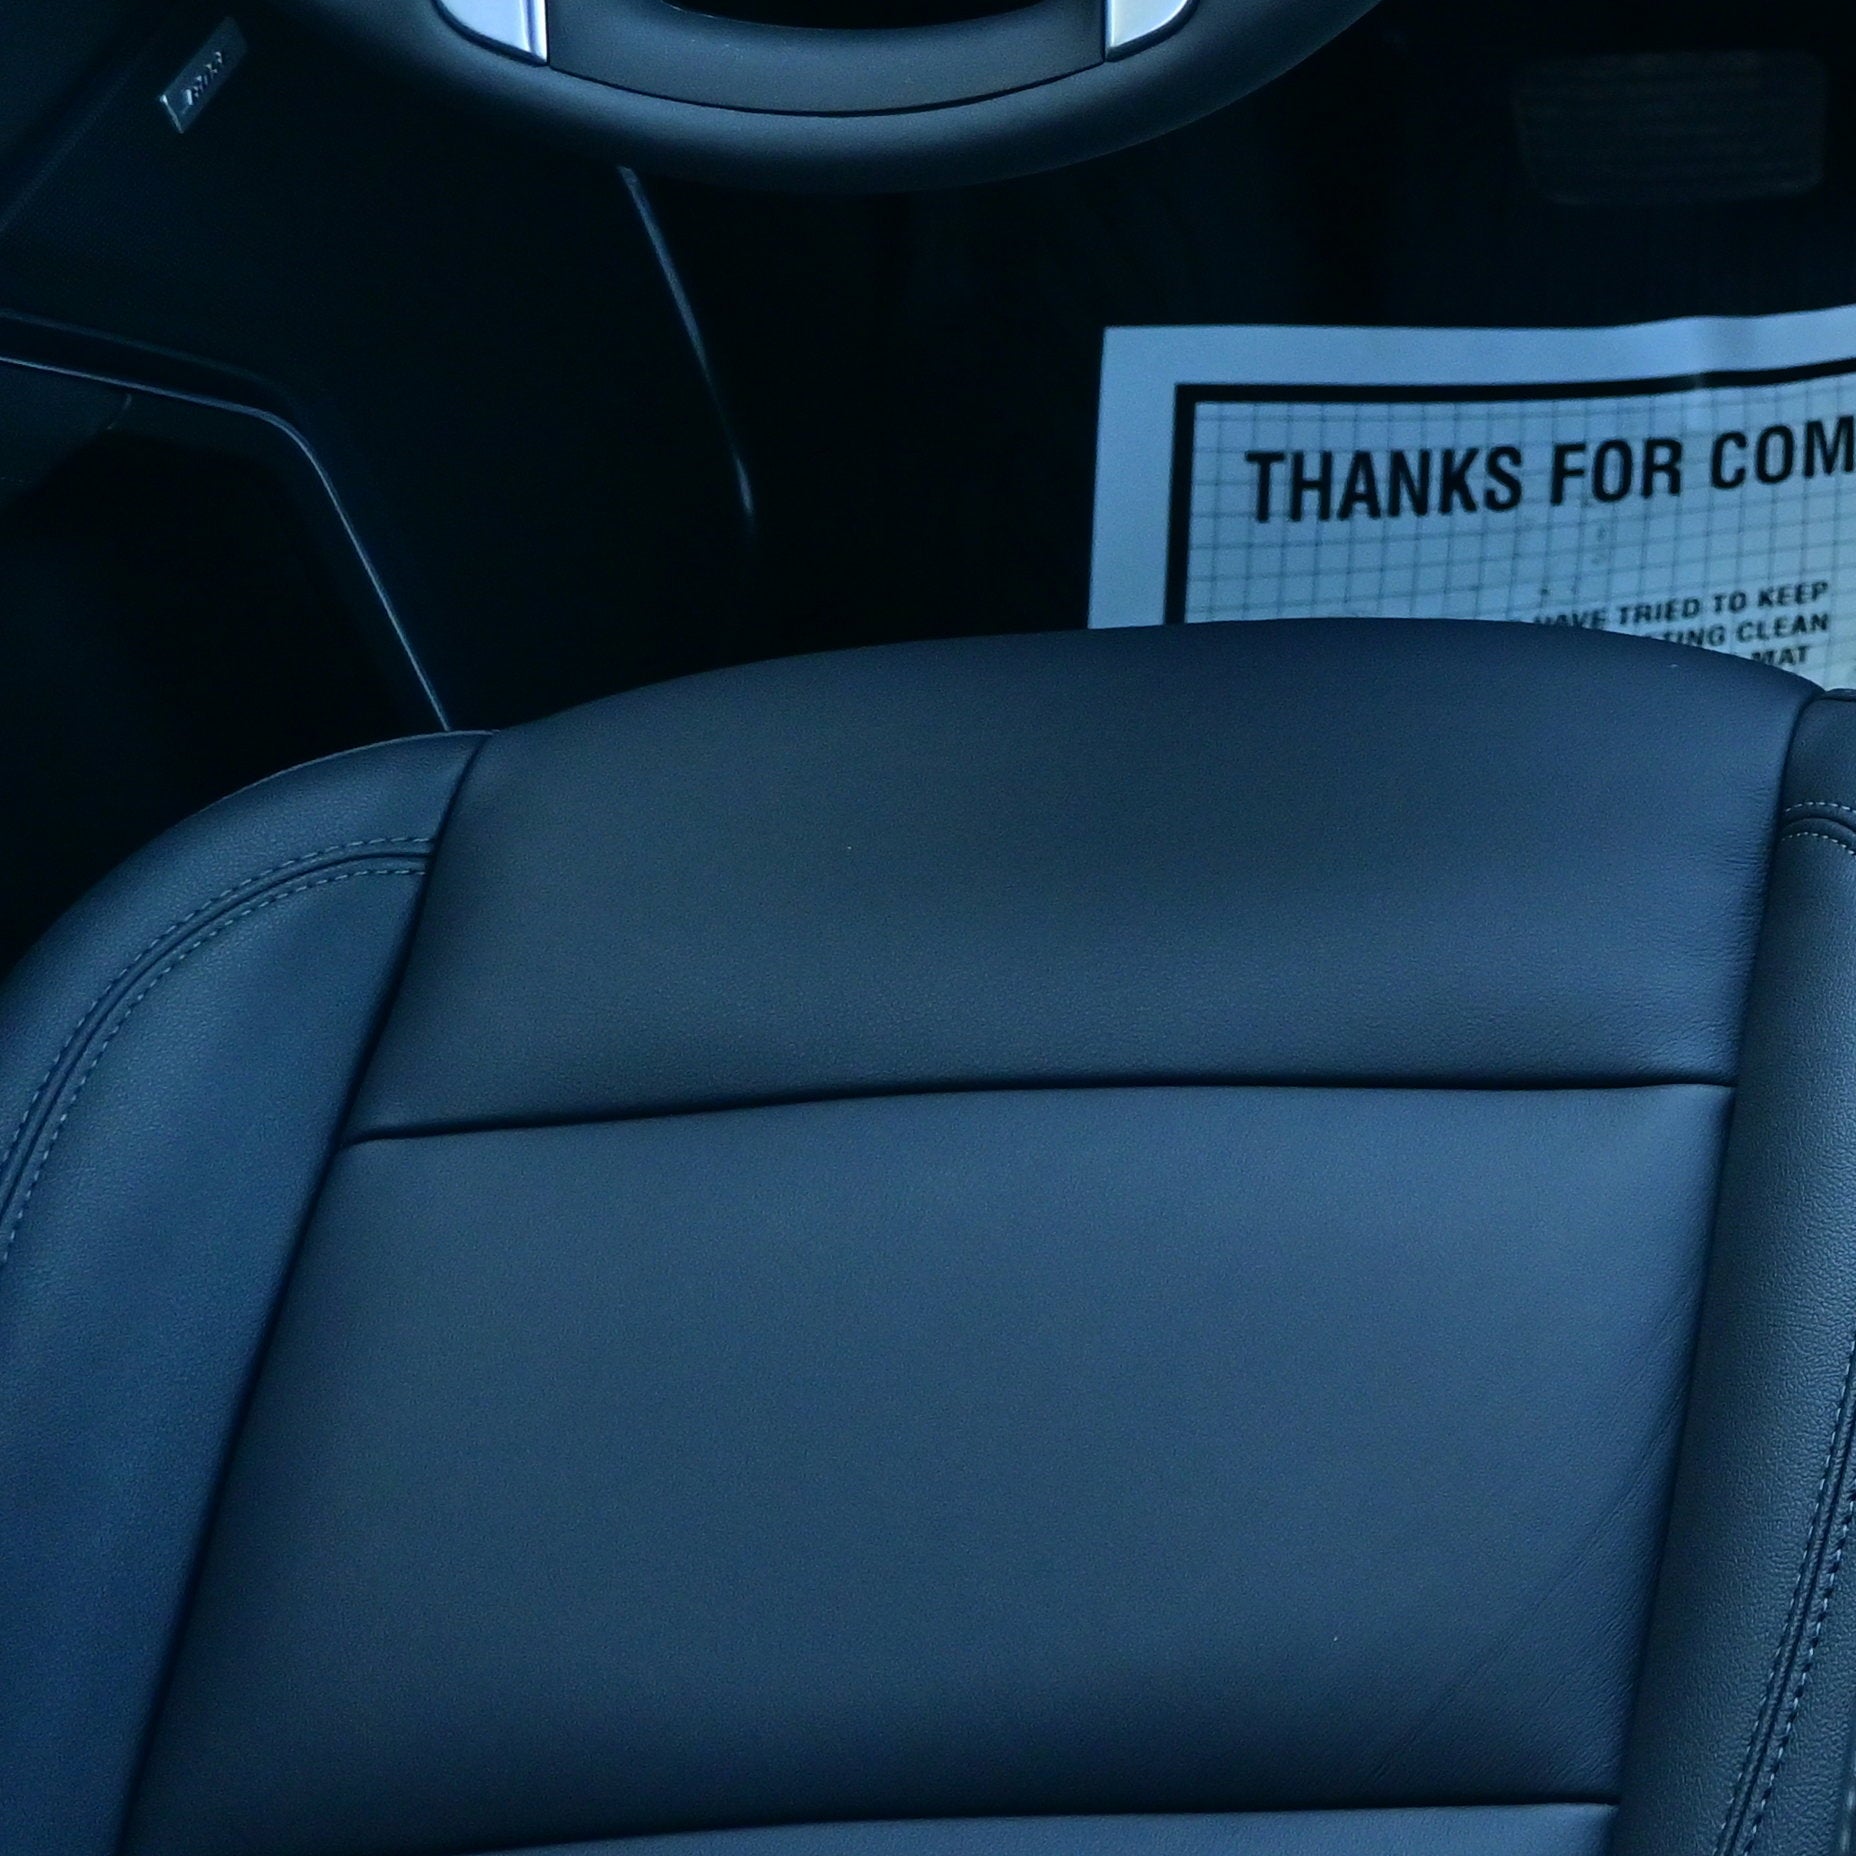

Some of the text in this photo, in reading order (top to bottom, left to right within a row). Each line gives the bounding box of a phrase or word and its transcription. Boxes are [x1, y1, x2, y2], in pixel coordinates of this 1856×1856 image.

[1244, 445, 1523, 523] THANKS
[1549, 437, 1685, 506] FOR
[1619, 581, 1830, 626] TRIED TO KEEP
[1736, 612, 1830, 643] CLEAN
[1751, 645, 1809, 666] MAT
